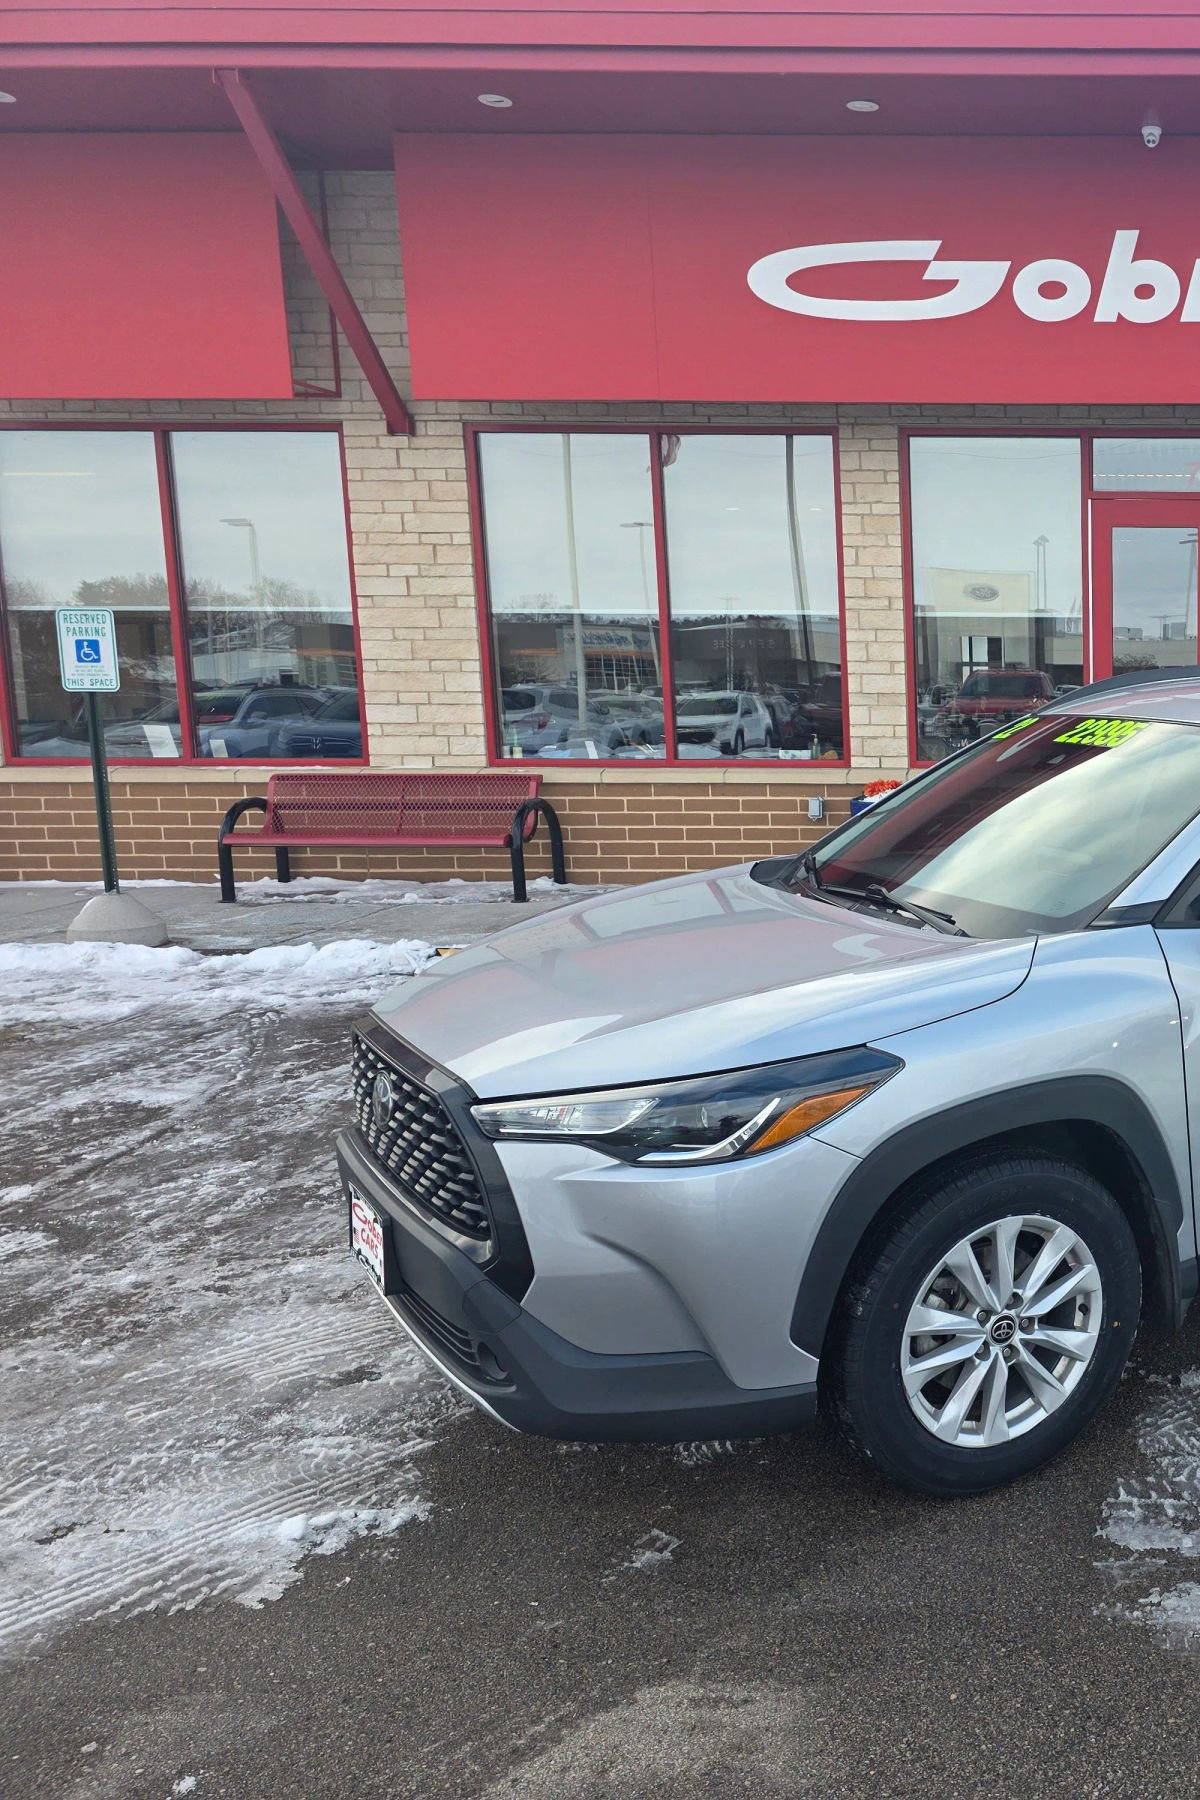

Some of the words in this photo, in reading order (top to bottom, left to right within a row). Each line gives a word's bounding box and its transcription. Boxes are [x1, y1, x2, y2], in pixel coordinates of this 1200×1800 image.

[63, 613, 107, 625] RESERVED
[66, 626, 106, 637] PARKING
[66, 678, 85, 687] THIS
[89, 678, 115, 687] SPACE
[1054, 718, 1149, 748] 22995
[360, 1228, 379, 1260] CARS
